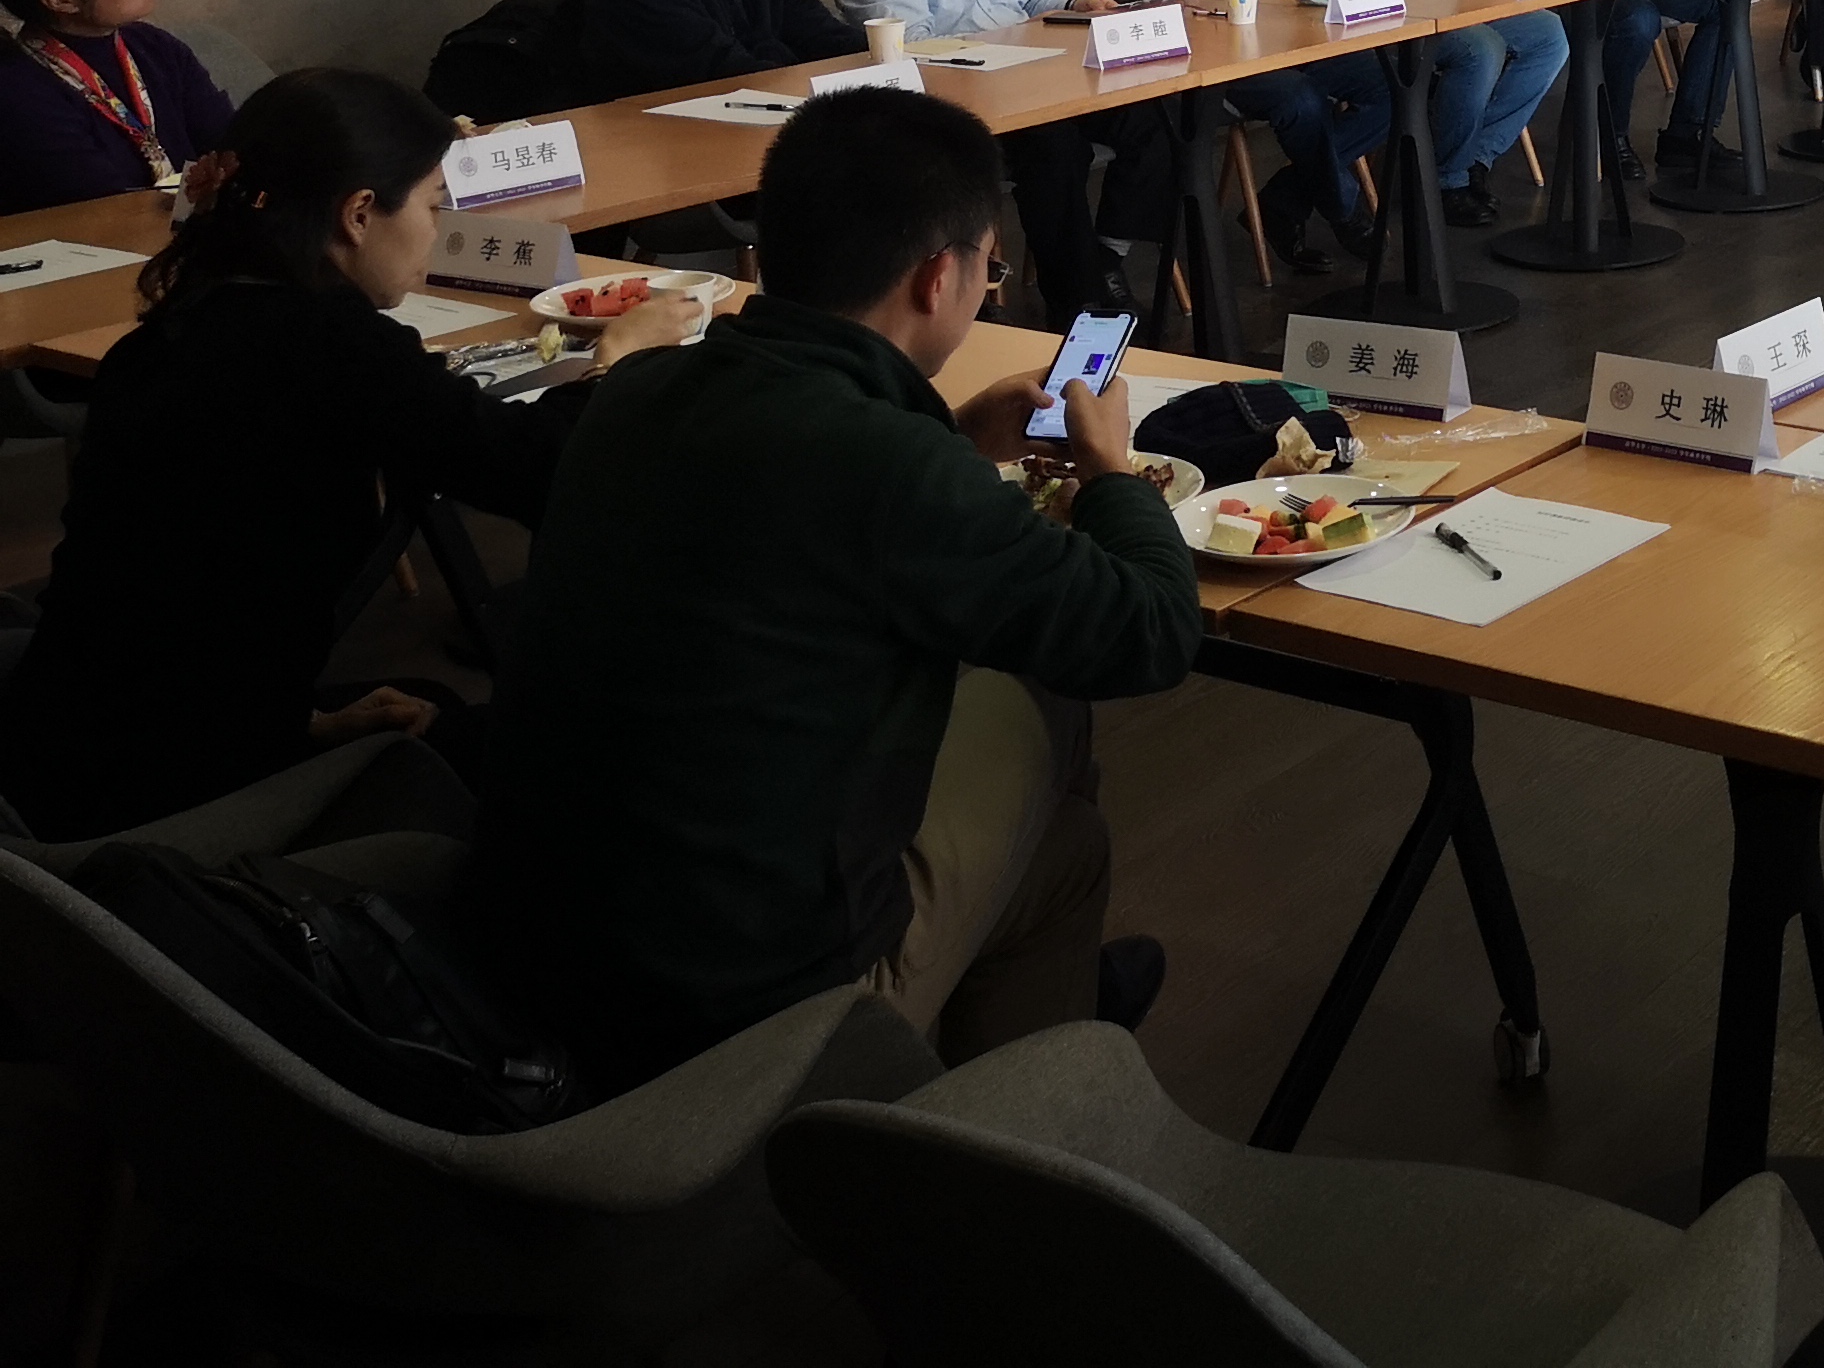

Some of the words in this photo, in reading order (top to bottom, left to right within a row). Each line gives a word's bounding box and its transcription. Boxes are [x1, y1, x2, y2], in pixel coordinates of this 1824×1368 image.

[1129, 19, 1168, 41] 李睦
[490, 141, 558, 172] 马昱春
[480, 236, 536, 266] 李蕉
[1348, 342, 1420, 380] 姜海
[1768, 329, 1812, 372] 王琛
[1654, 388, 1730, 430] 史琳
